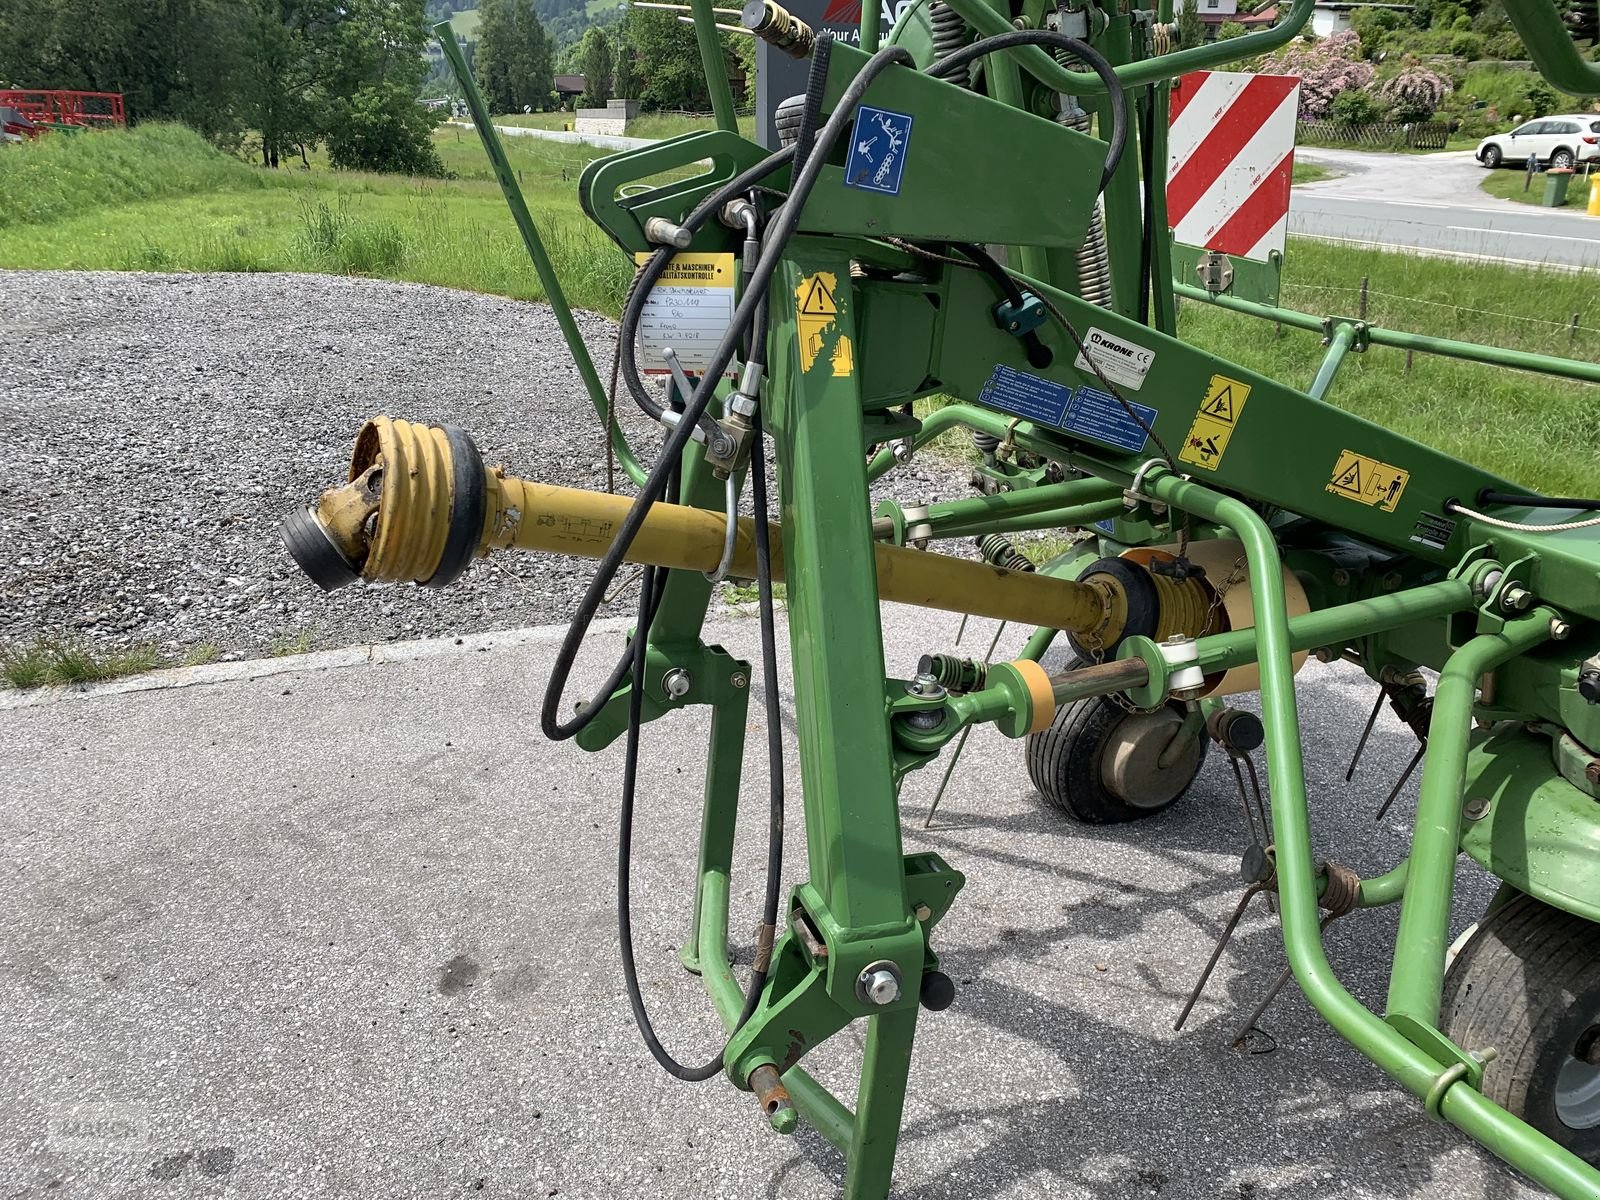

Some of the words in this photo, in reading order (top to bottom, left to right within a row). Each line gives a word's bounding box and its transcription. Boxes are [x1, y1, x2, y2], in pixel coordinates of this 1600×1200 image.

[676, 263, 681, 271] &
[682, 263, 715, 272] MASCHINEN
[1099, 340, 1135, 358] KRONE
